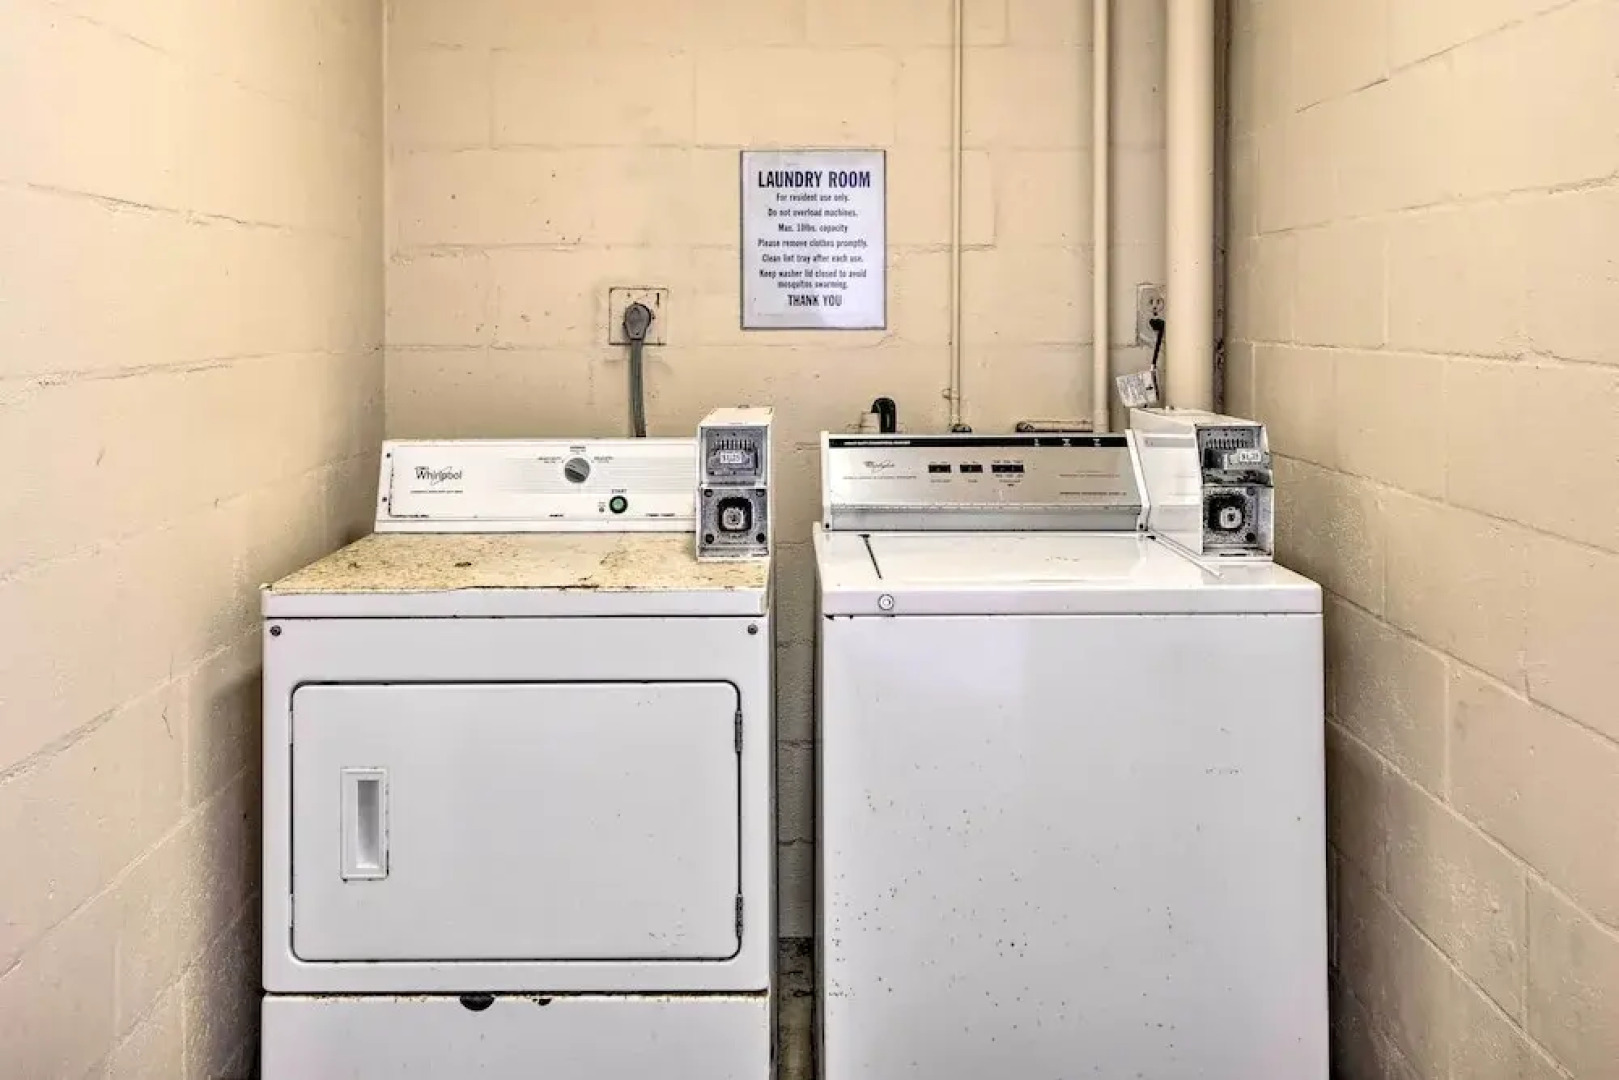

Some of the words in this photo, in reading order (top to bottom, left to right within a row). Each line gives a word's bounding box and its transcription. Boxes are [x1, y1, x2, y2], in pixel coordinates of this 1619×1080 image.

[758, 171, 822, 188] LAUNDRY
[829, 171, 870, 188] ROOM
[777, 193, 787, 201] For
[789, 193, 817, 201] resident
[834, 193, 850, 203] only.
[824, 209, 858, 217] machines.
[819, 224, 848, 233] capacity
[758, 239, 780, 247] Please
[809, 239, 834, 247] clothes
[837, 239, 868, 248] promptly.
[762, 254, 780, 262] Clean
[783, 254, 794, 262] lint
[796, 255, 811, 263] tray
[813, 254, 829, 262] after
[832, 254, 848, 262] each
[759, 270, 776, 278] Keep
[788, 294, 819, 306] THANK
[822, 294, 842, 306] YOU
[415, 470, 463, 481] Whirlpool
